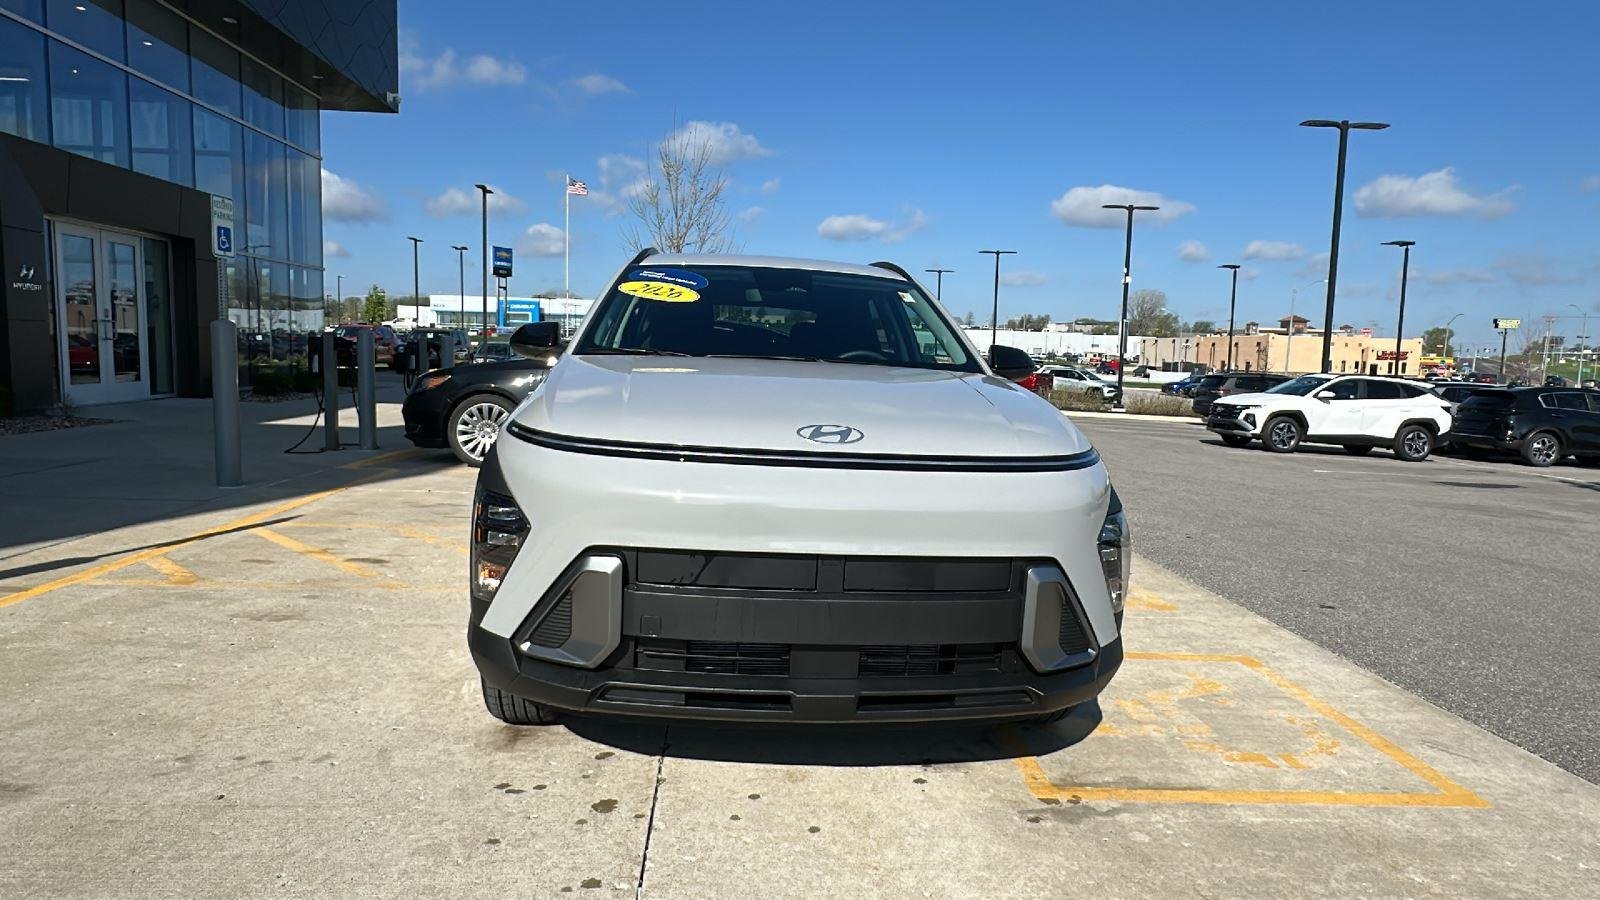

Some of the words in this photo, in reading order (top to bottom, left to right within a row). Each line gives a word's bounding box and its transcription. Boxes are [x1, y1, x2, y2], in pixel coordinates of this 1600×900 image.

[213, 210, 232, 221] PARKING
[13, 282, 42, 291] HYUNDAI
[628, 283, 683, 298] 2026
